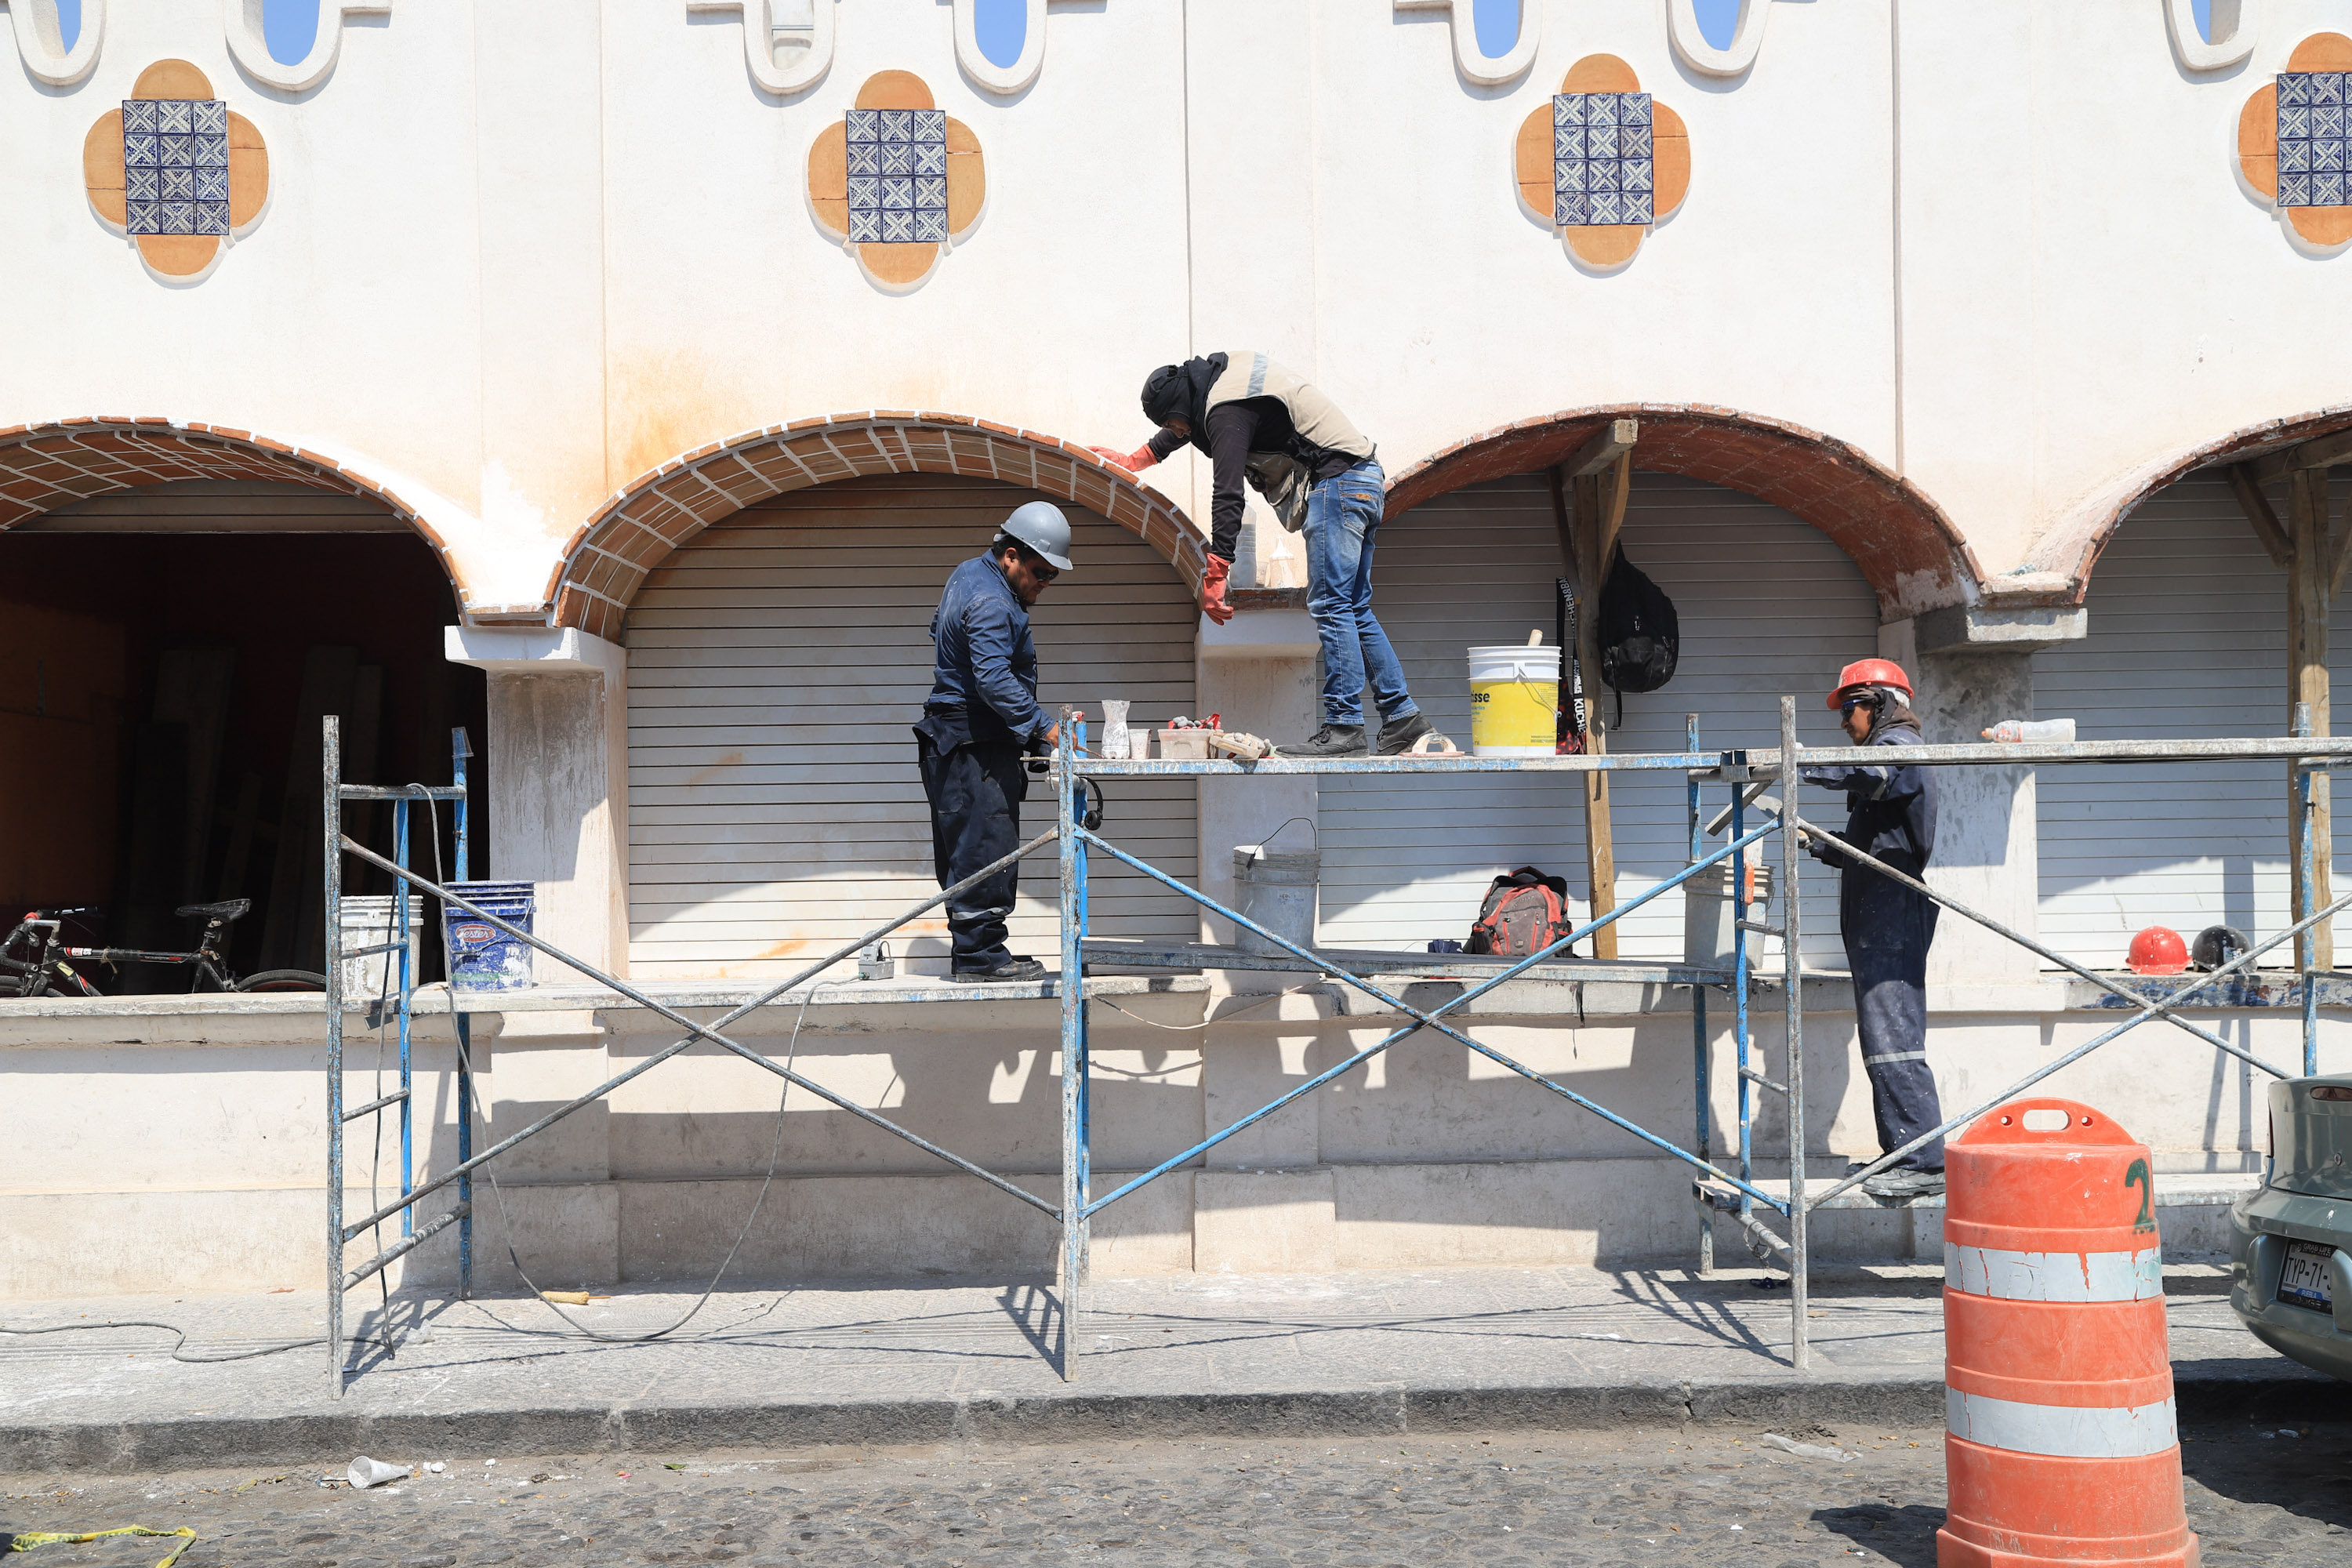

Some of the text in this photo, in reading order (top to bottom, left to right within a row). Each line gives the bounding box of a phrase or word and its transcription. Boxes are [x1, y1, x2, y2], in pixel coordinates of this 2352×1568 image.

[2125, 1158, 2156, 1234] 2
[2303, 1243, 2318, 1251] GRAB
[2285, 1257, 2331, 1290] TYP-71-
